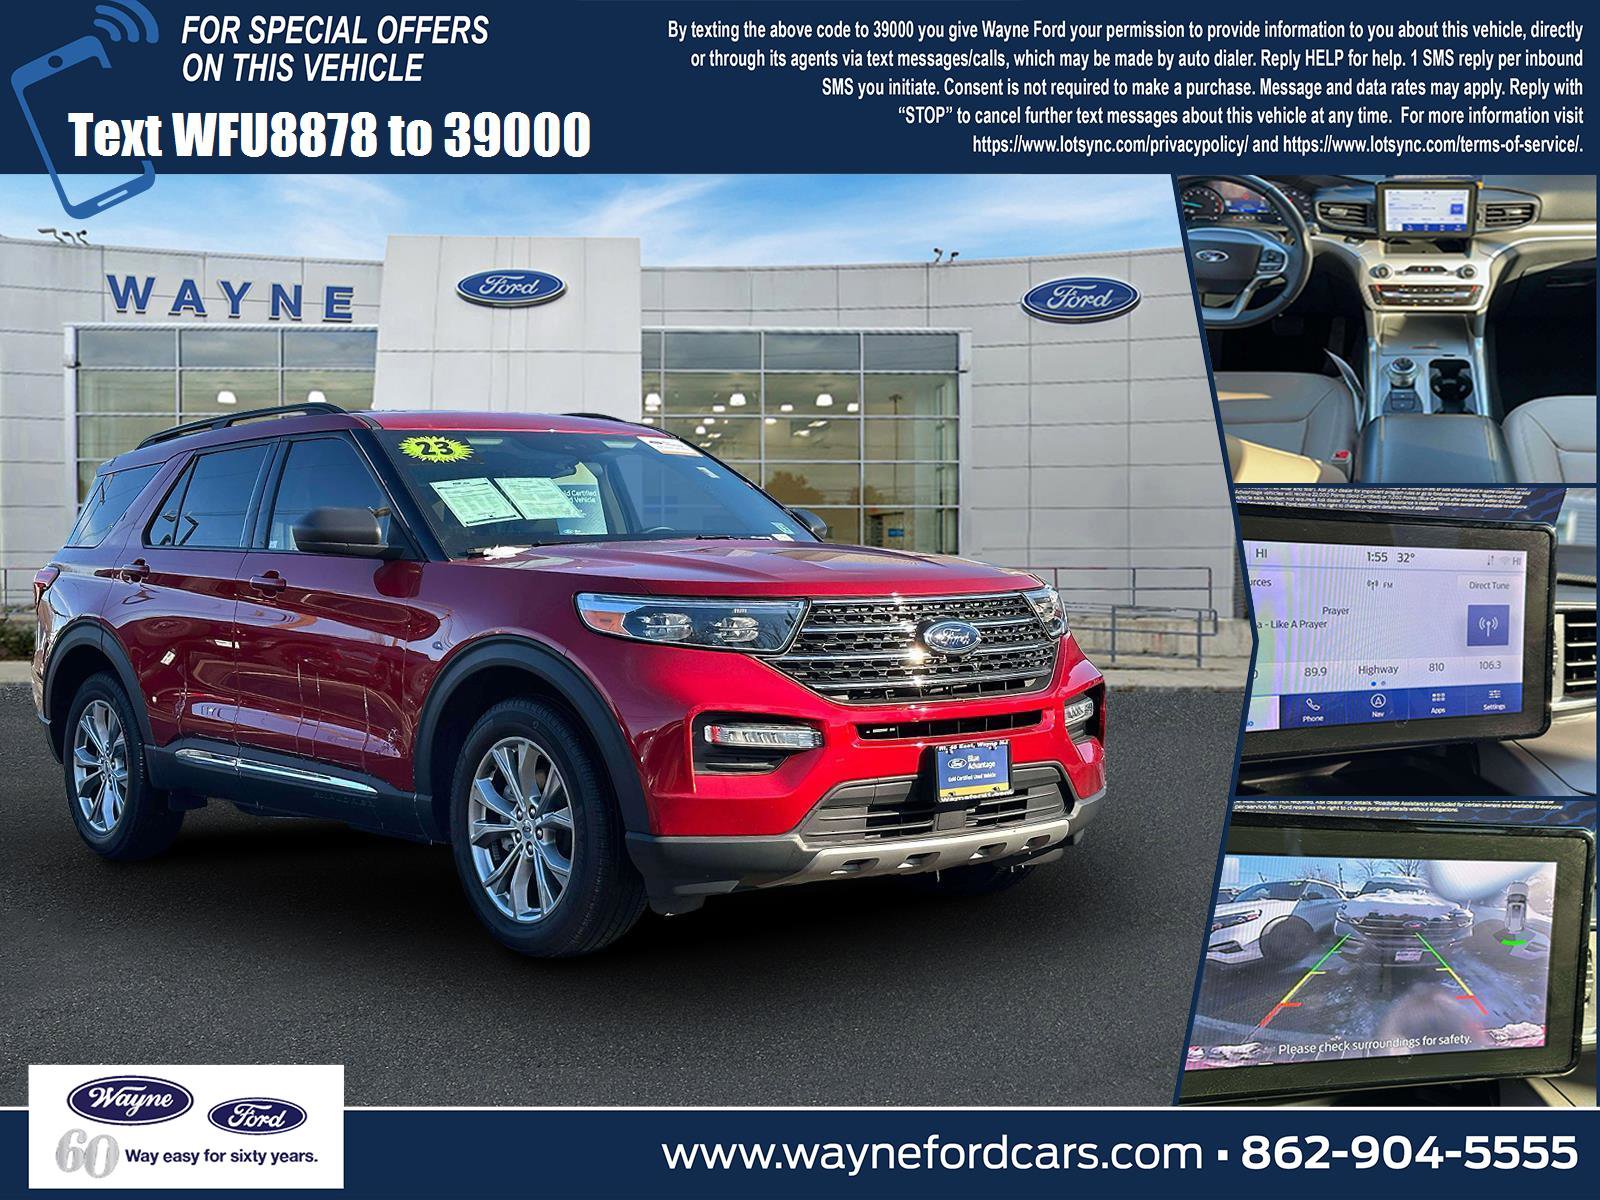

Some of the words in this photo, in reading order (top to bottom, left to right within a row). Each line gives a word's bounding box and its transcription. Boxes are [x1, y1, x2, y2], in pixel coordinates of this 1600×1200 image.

[478, 274, 541, 295] Ford
[106, 274, 354, 319] WAYNE
[1046, 284, 1114, 309] Ford
[414, 441, 454, 455] 23
[1255, 548, 1268, 559] HI
[1366, 551, 1389, 563] 1:55
[1250, 579, 1272, 587] urces
[1469, 581, 1492, 590] Direct
[1492, 581, 1511, 590] Tune
[1322, 606, 1350, 616] Prayer
[1270, 620, 1290, 630] Like
[1290, 620, 1298, 629] A
[1299, 620, 1328, 630] Prayer
[1358, 665, 1399, 676] Highway
[1428, 662, 1445, 672] 810
[1479, 660, 1502, 671] 106.3
[1304, 666, 1328, 677] 89.9
[1430, 707, 1446, 716] Apps
[1483, 703, 1507, 712] Settings
[1302, 715, 1325, 723] Phone
[967, 761, 996, 770] Advantage
[1278, 1043, 1317, 1055] Please
[1319, 1041, 1350, 1053] check
[1352, 1037, 1421, 1051] surroundings
[1422, 1034, 1437, 1046] for
[1438, 1033, 1473, 1047] safety.
